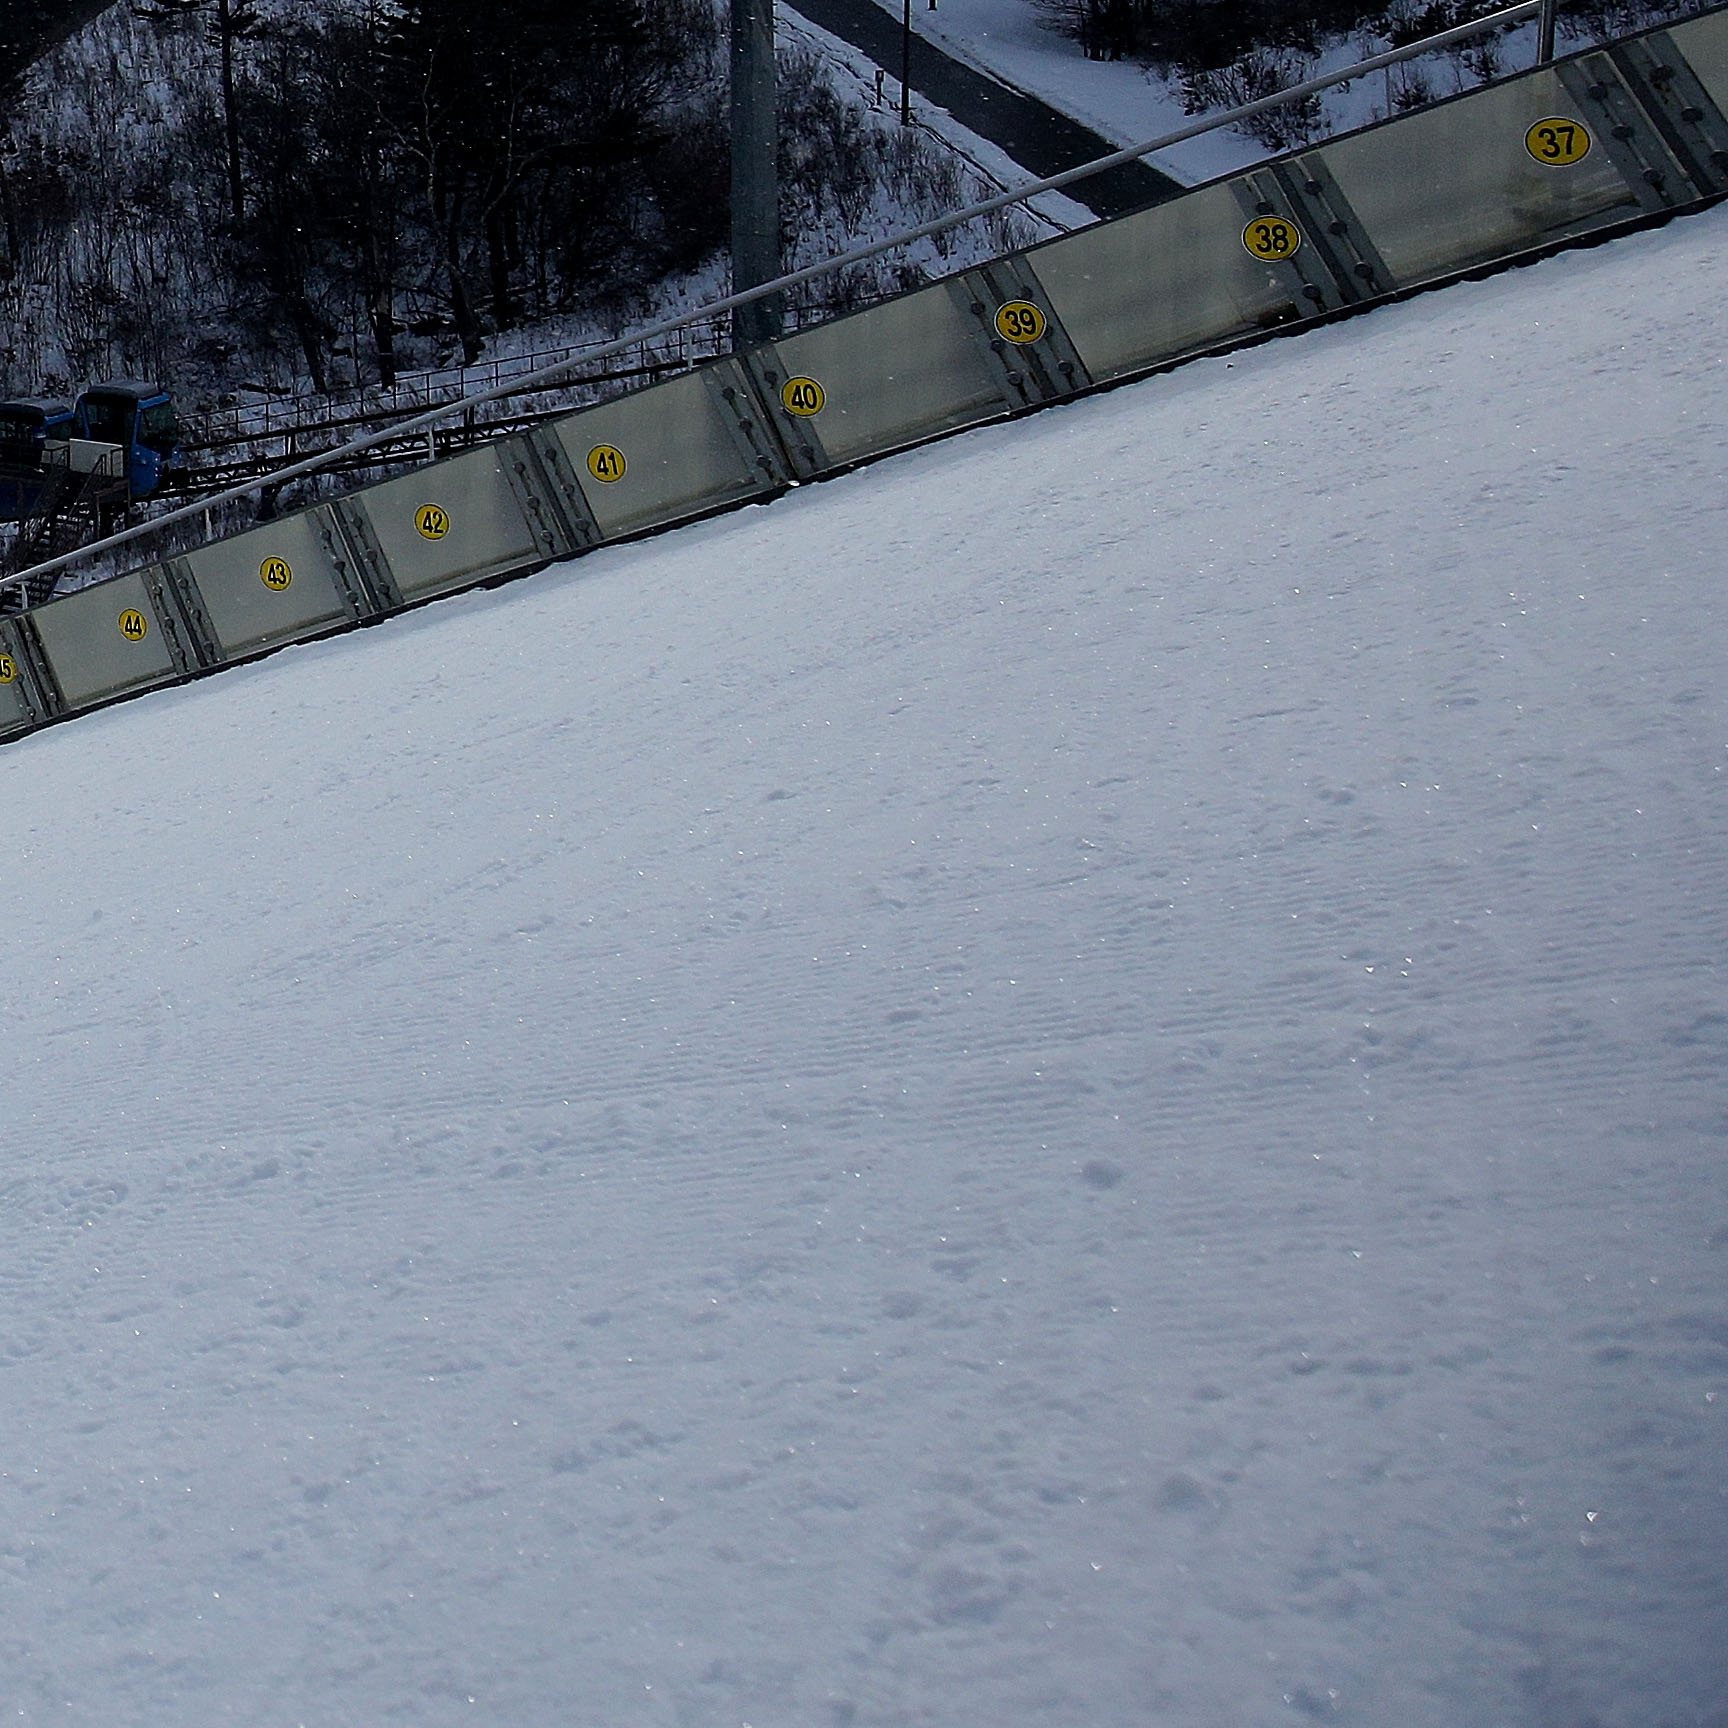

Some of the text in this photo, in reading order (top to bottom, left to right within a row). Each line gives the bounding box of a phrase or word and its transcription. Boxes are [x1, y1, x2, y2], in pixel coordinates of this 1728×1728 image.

[1538, 126, 1575, 159] 37
[1255, 224, 1290, 254] 38
[1004, 308, 1037, 337] 39
[791, 383, 818, 410] 40
[596, 451, 618, 476] 41
[422, 510, 444, 534] 42
[267, 562, 287, 585] 43
[125, 614, 144, 636] 44
